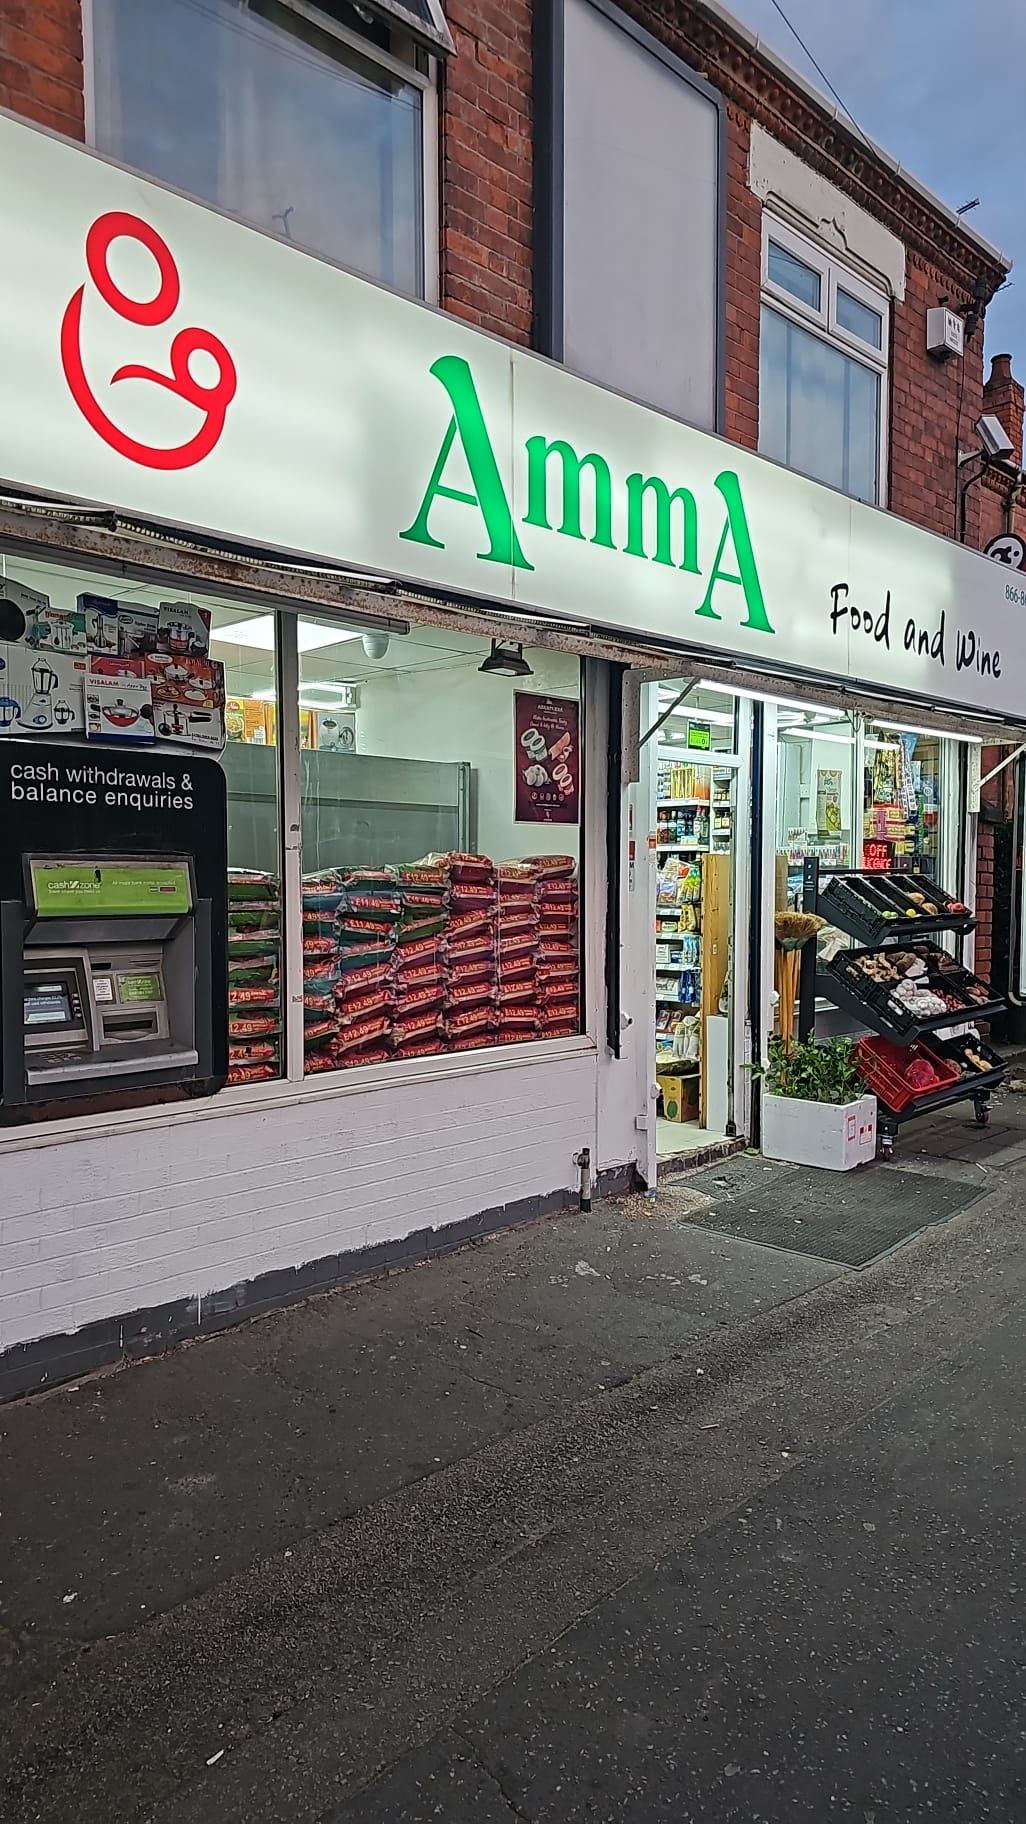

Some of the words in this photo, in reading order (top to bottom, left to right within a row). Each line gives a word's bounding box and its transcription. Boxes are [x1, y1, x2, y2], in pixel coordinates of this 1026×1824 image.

[399, 355, 775, 635] AmmA
[1005, 584, 1026, 606] 866-8
[830, 583, 890, 651] Food
[904, 609, 945, 666] and
[956, 630, 1001, 678] Wine
[89, 678, 120, 686] VISALAM
[10, 762, 58, 781] cash
[65, 765, 176, 792] withdrawals
[180, 773, 194, 790] &
[11, 781, 96, 804] balance
[104, 791, 193, 811] enquiries
[870, 844, 888, 857] OFF
[343, 1027, 370, 1041] £12.49
